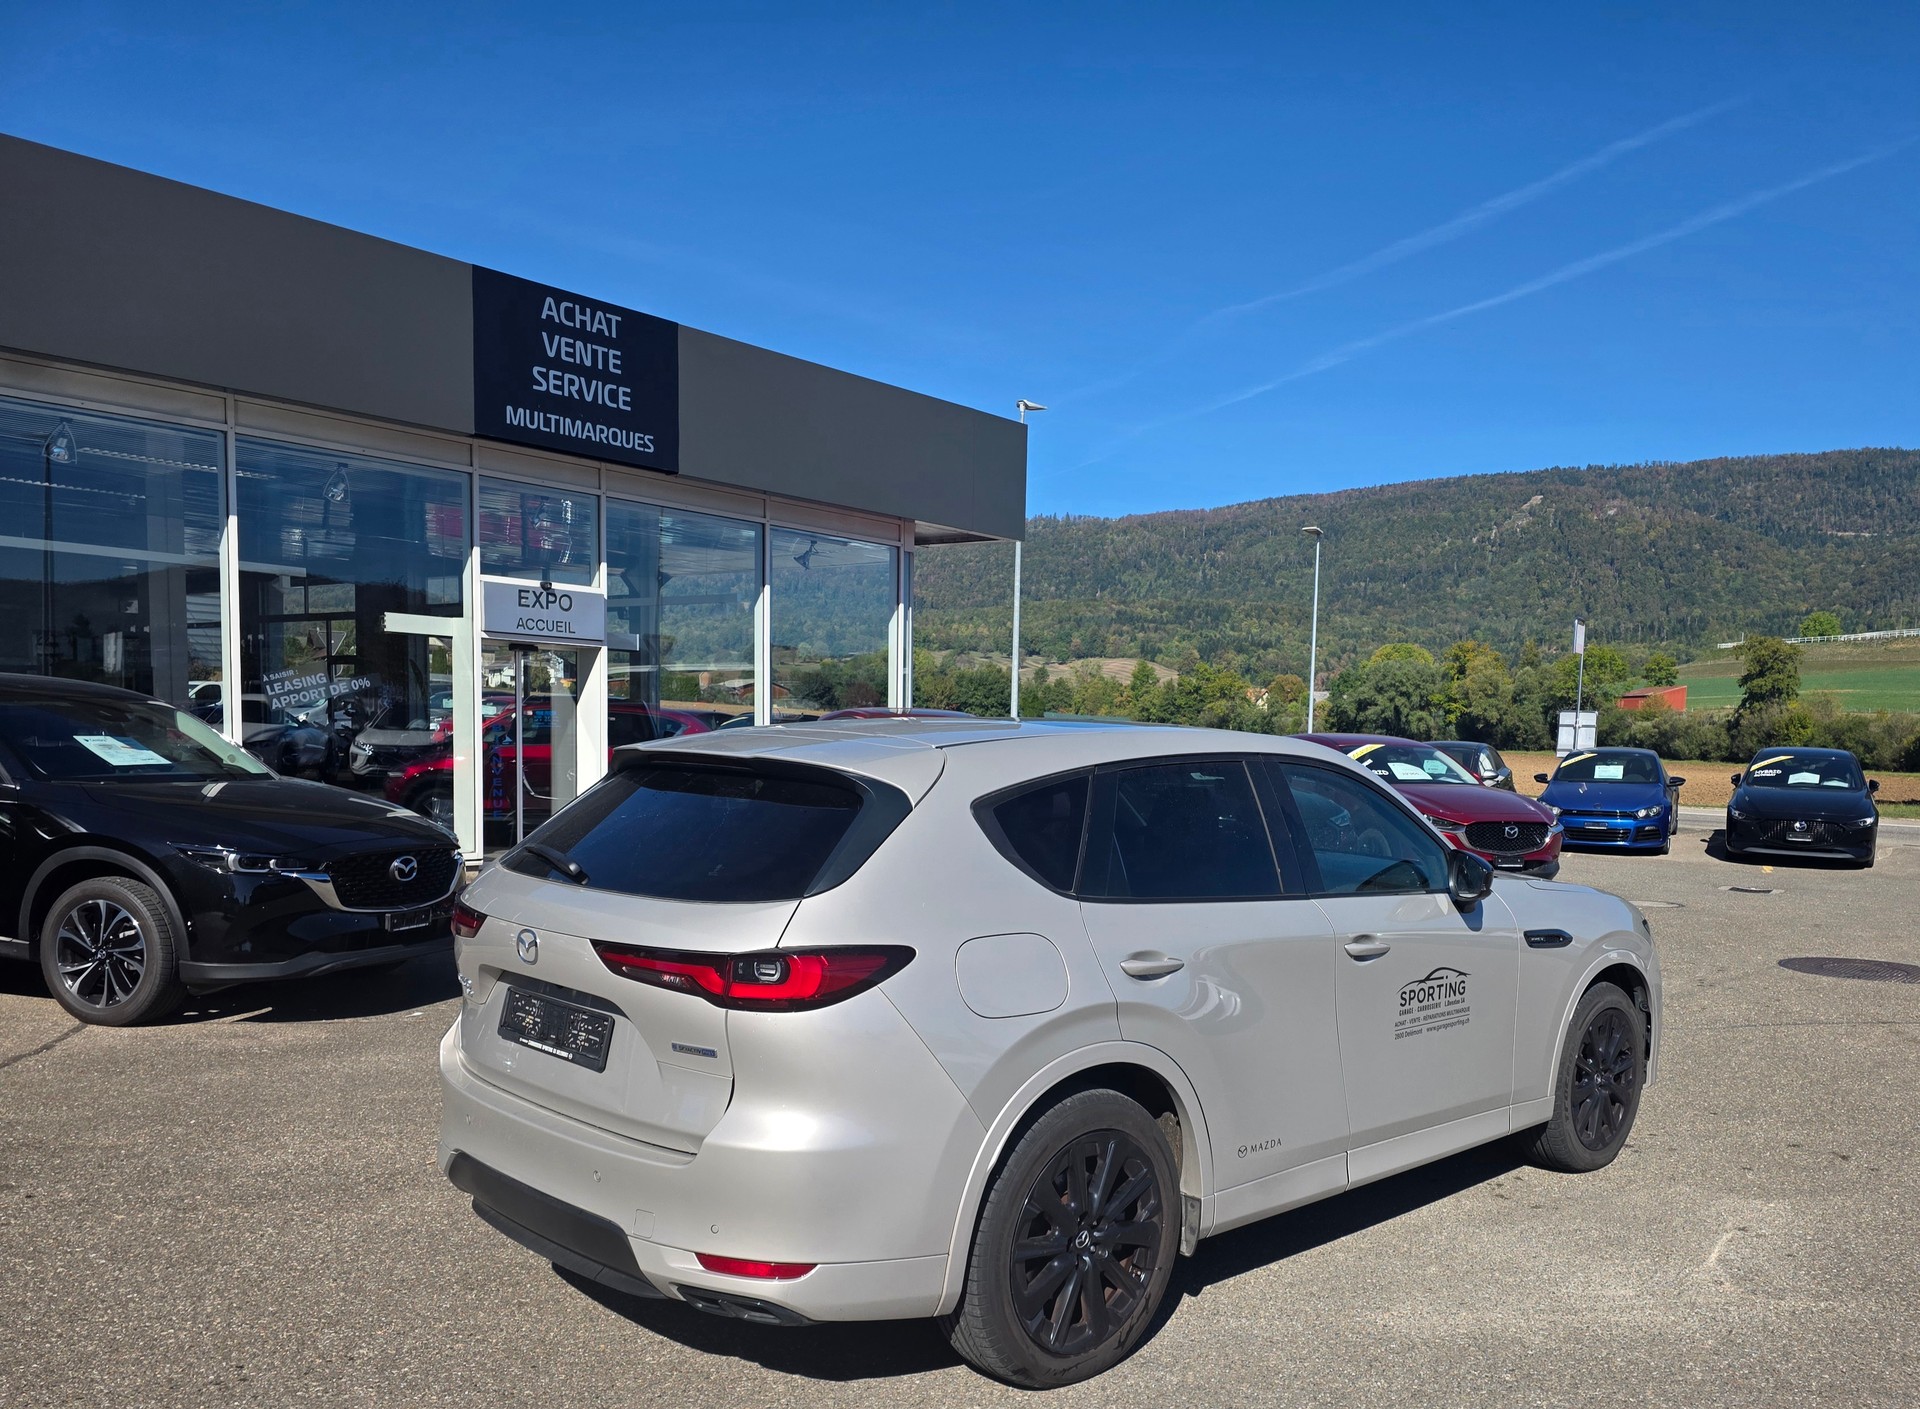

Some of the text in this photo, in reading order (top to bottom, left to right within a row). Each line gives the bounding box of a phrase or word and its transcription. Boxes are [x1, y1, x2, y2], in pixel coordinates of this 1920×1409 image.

[541, 296, 622, 338] ACHAT
[541, 331, 622, 375] VENTE
[532, 365, 631, 411] SERVICE
[506, 405, 655, 453] MULTIMARQUES
[518, 589, 573, 612] EXPO
[516, 617, 576, 634] ACCUEIL
[265, 673, 327, 696] LEASING
[269, 669, 295, 680] SAISIR
[271, 677, 371, 710] APPORT DE 0%
[1399, 980, 1466, 1007] SPORTING
[1250, 1138, 1282, 1154] MAZDA
